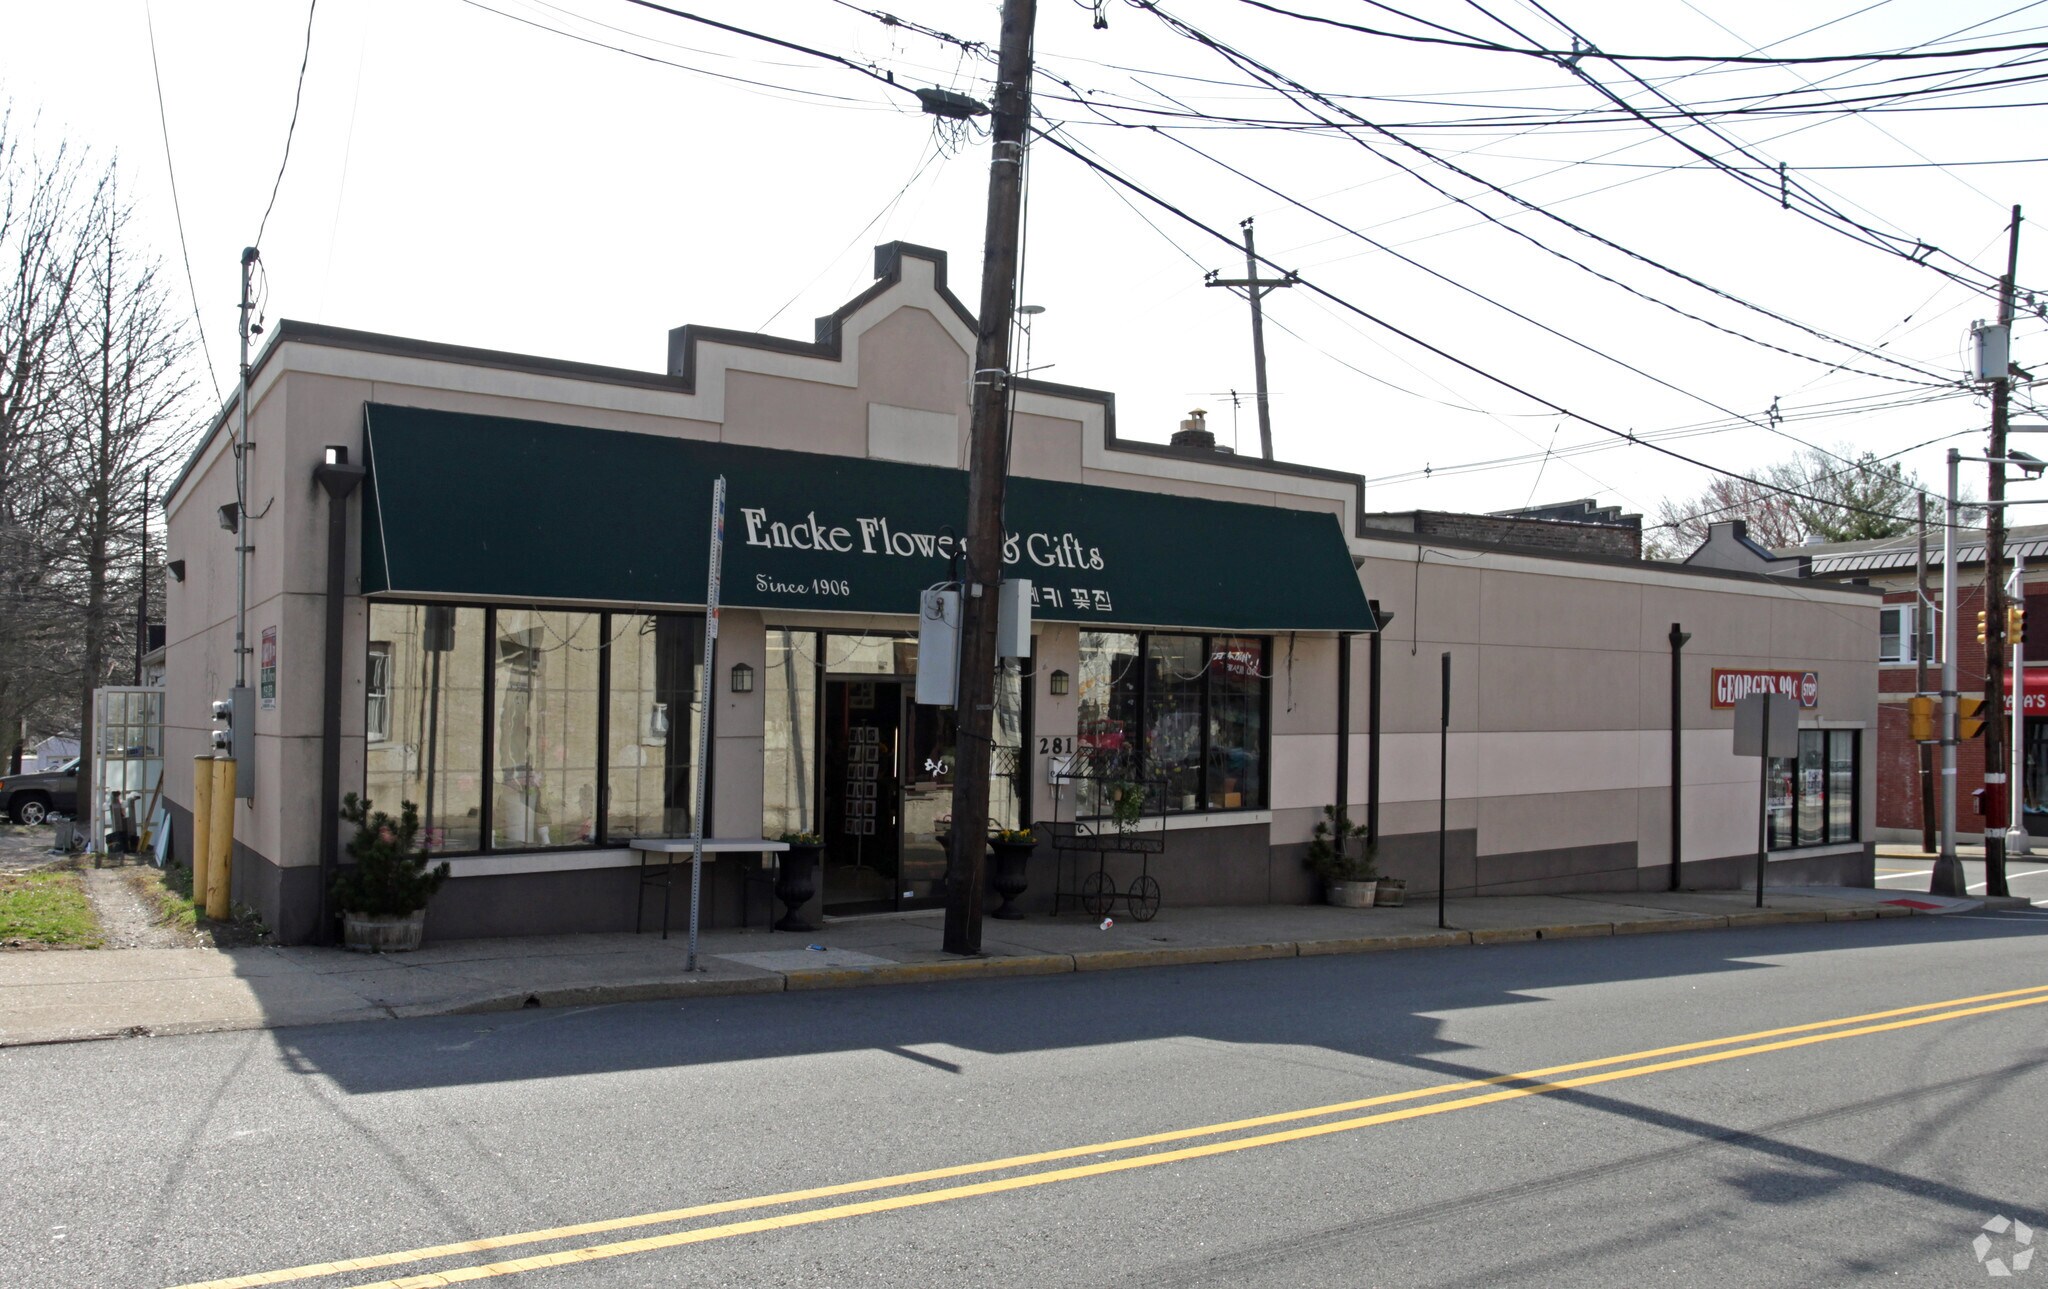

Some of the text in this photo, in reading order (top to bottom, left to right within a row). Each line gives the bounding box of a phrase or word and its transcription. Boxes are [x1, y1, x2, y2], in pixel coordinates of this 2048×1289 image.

[740, 507, 853, 553] Encke
[1026, 532, 1104, 571] Gifts
[755, 573, 850, 596] Since 1906
[1070, 587, 1113, 612] 꽃집
[1803, 683, 1816, 697] STOP
[1039, 737, 1073, 755] 281
